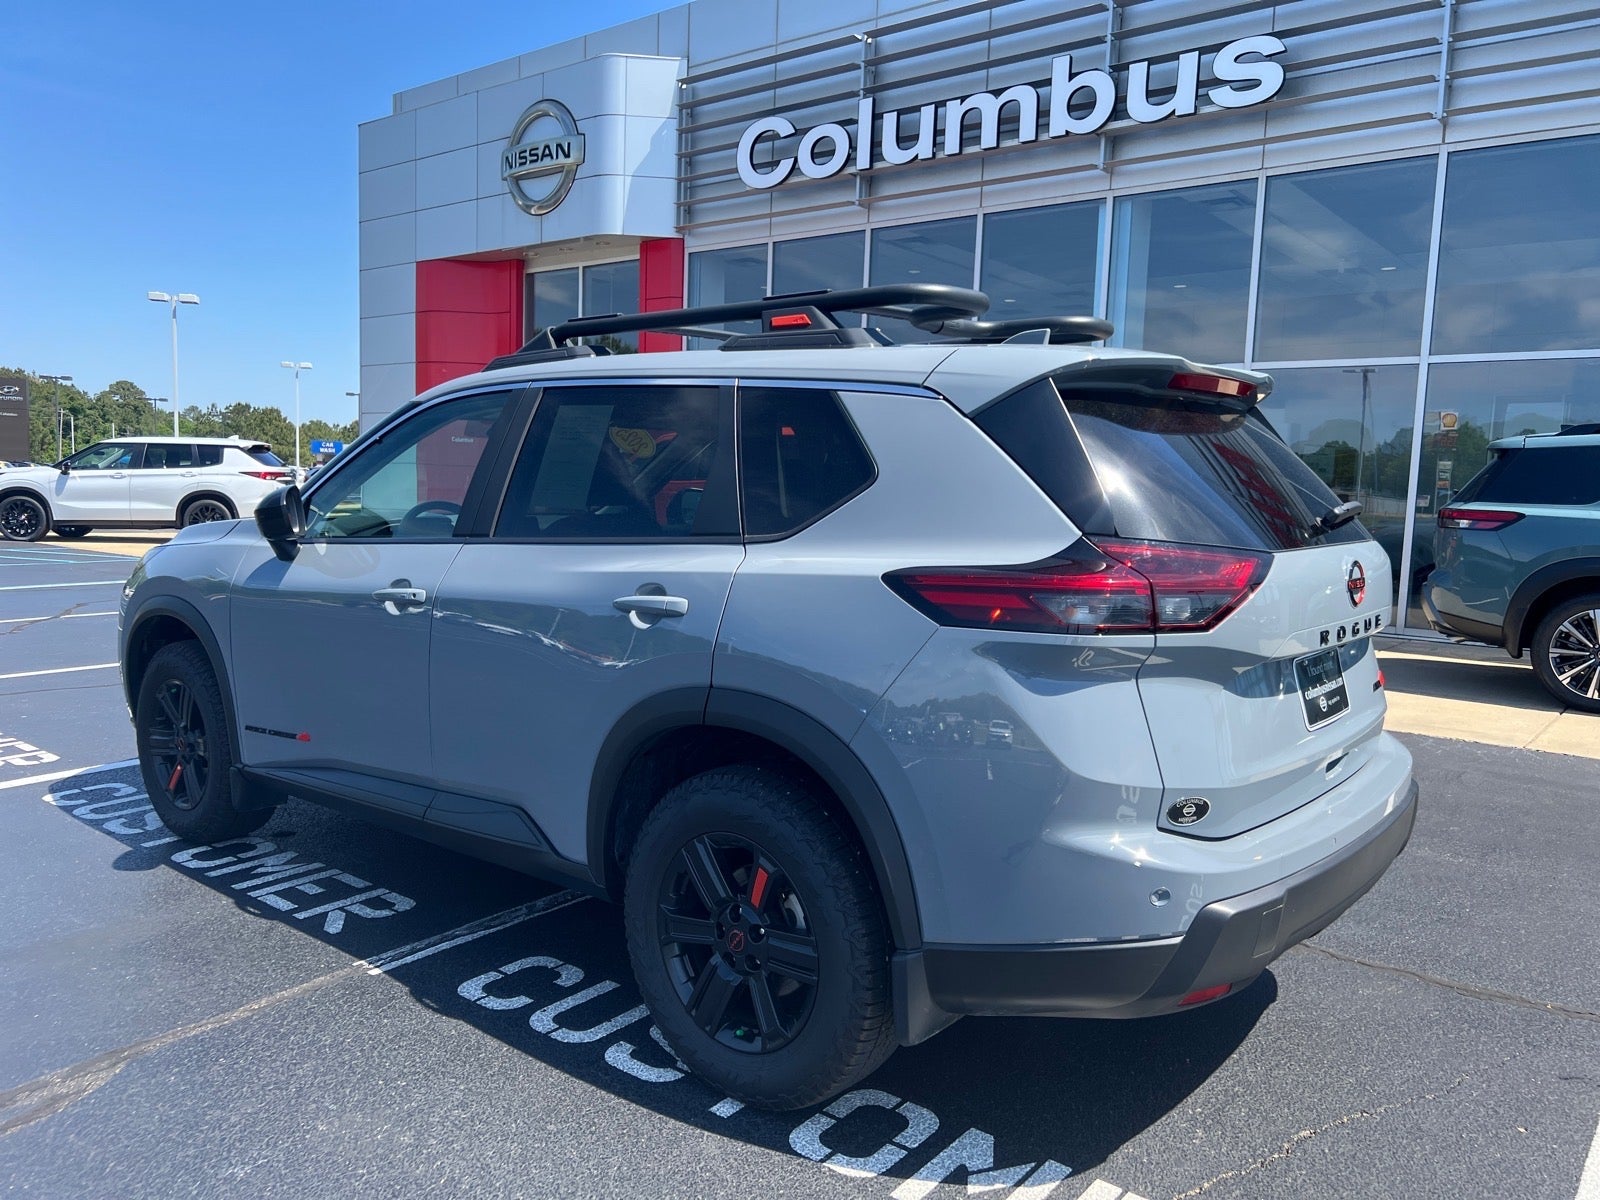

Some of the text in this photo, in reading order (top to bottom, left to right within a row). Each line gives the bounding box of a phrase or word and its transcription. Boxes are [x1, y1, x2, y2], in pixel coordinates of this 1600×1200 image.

[735, 35, 1287, 189] Columbus
[504, 141, 571, 172] NISSAN
[1319, 614, 1382, 647] ROGUE
[1304, 677, 1344, 701] columbusnissan.com
